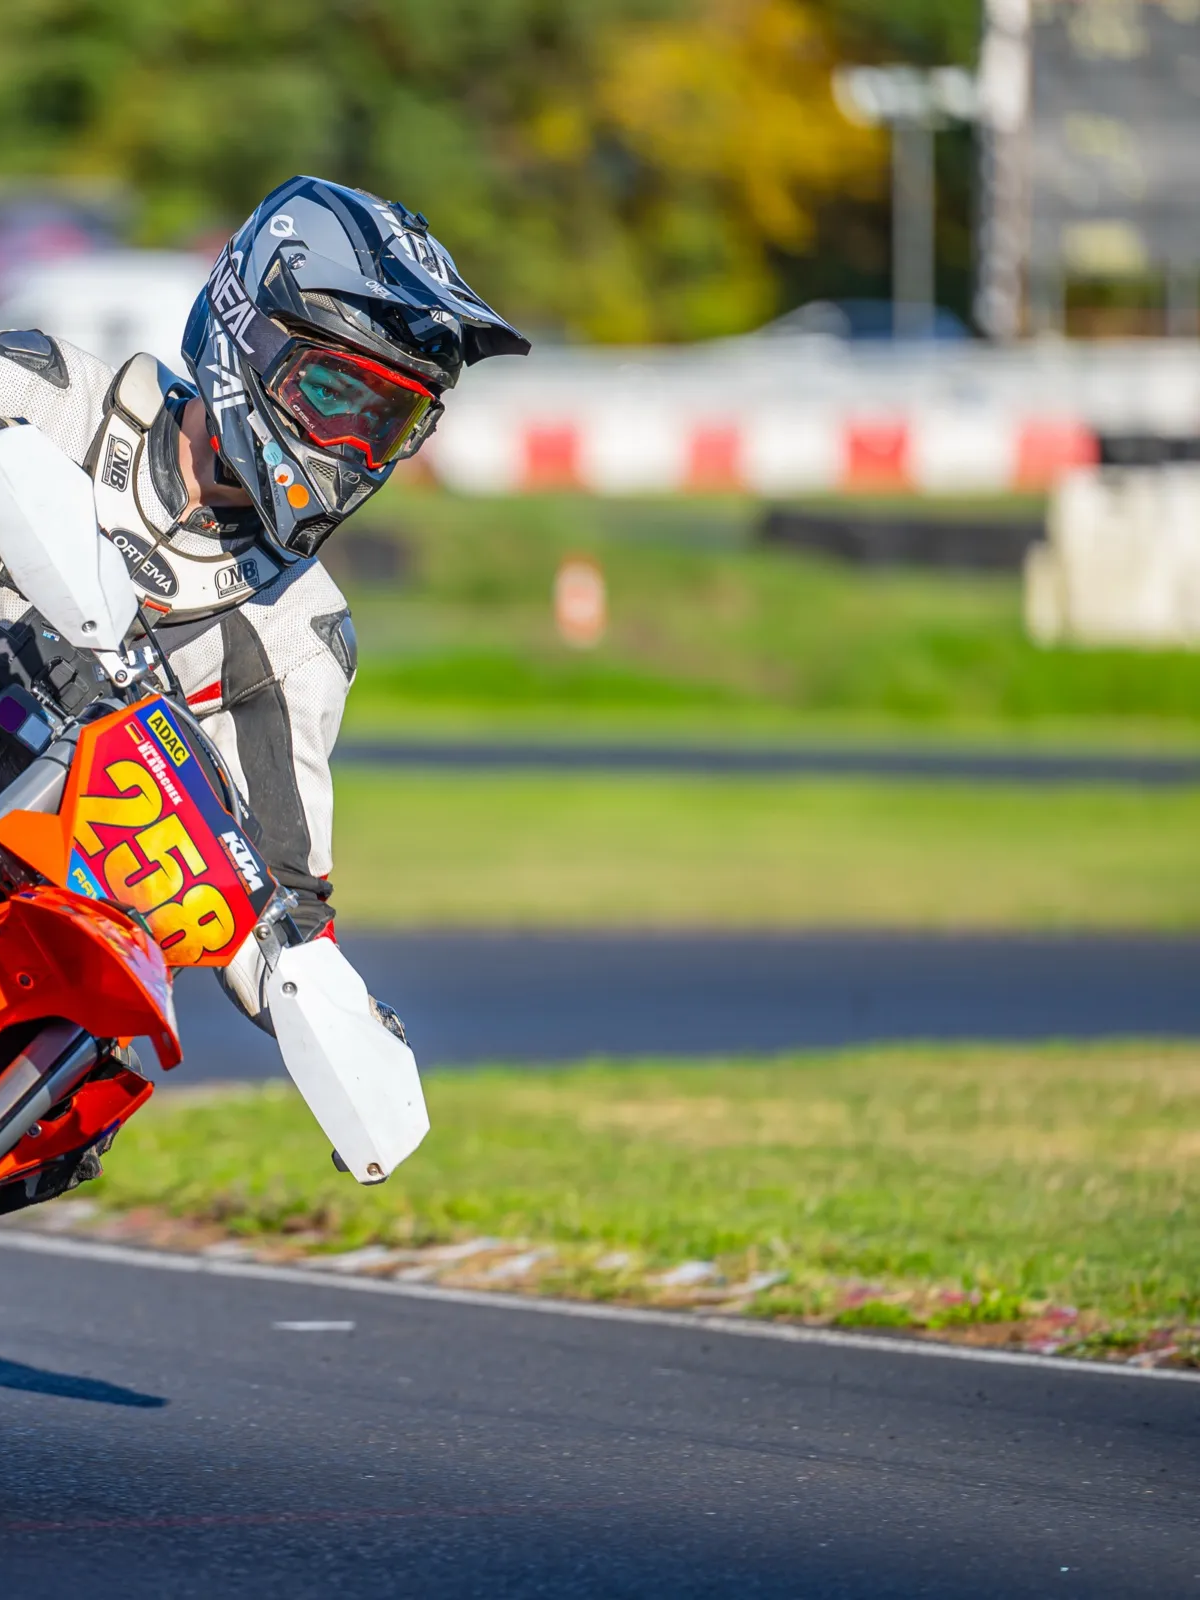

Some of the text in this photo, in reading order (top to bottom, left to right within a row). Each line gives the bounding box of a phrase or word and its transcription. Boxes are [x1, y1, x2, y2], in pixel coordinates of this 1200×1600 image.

[207, 244, 256, 355] NEAL
[205, 312, 246, 435] EAL
[113, 535, 173, 594] ORTEMA
[151, 716, 186, 762] ADAC
[72, 867, 98, 900] RA
[73, 759, 236, 963] 258
[220, 830, 264, 892] KTM
